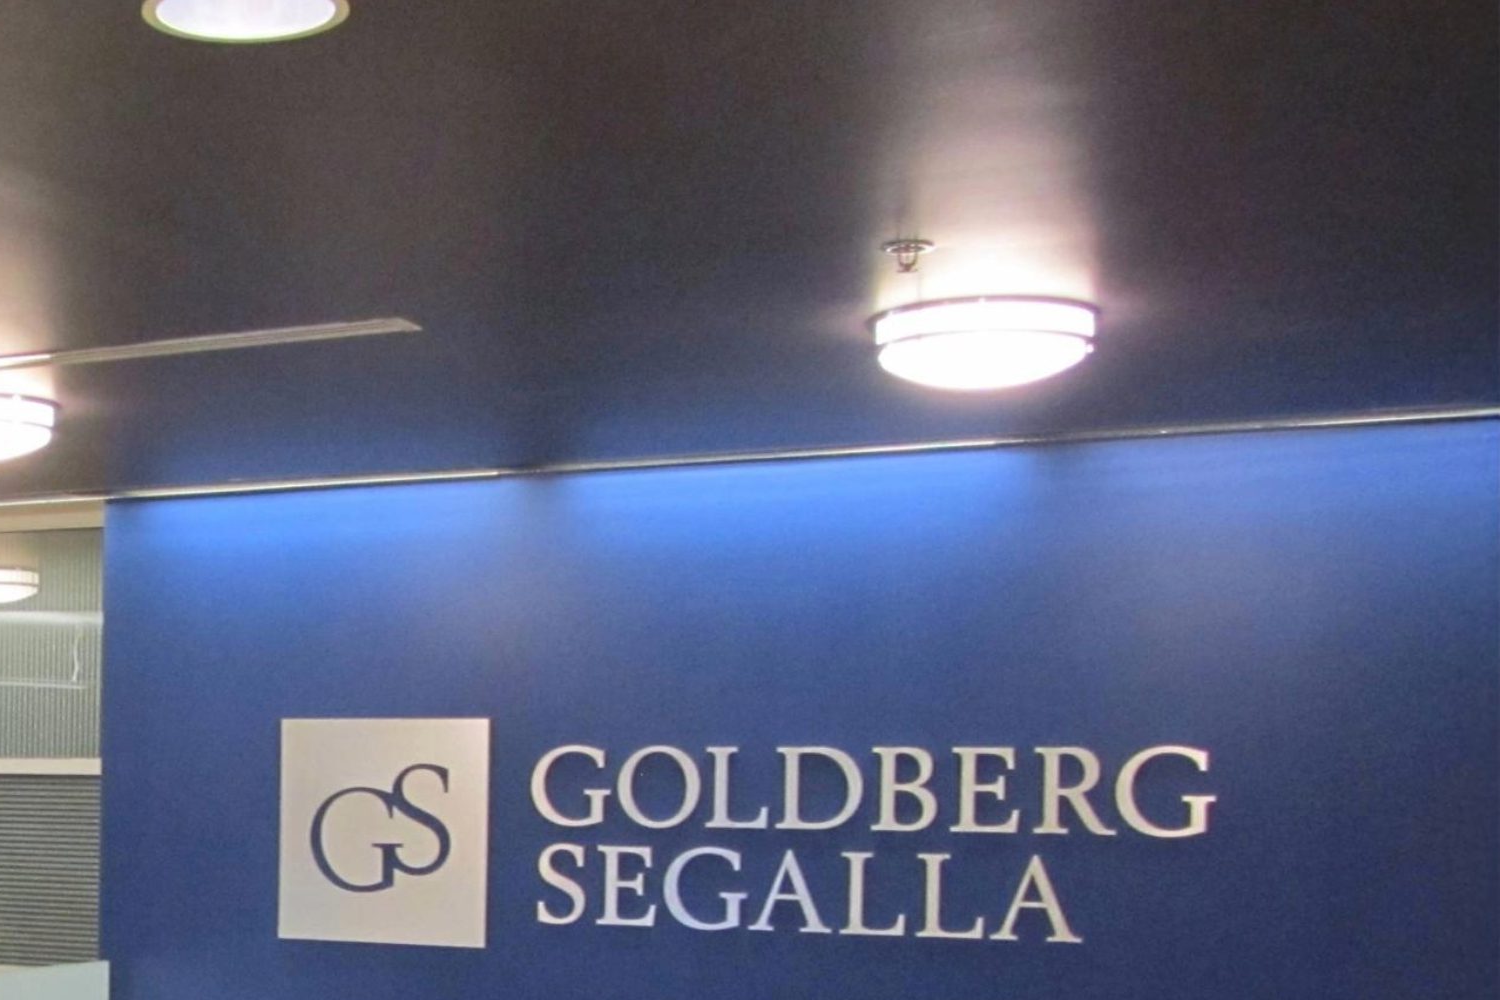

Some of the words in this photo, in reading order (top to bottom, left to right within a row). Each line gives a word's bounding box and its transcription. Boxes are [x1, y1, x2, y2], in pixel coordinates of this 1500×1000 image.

[310, 763, 451, 893] GS
[529, 743, 1217, 838] GOLDBERG
[535, 842, 1083, 943] SEGALLA
